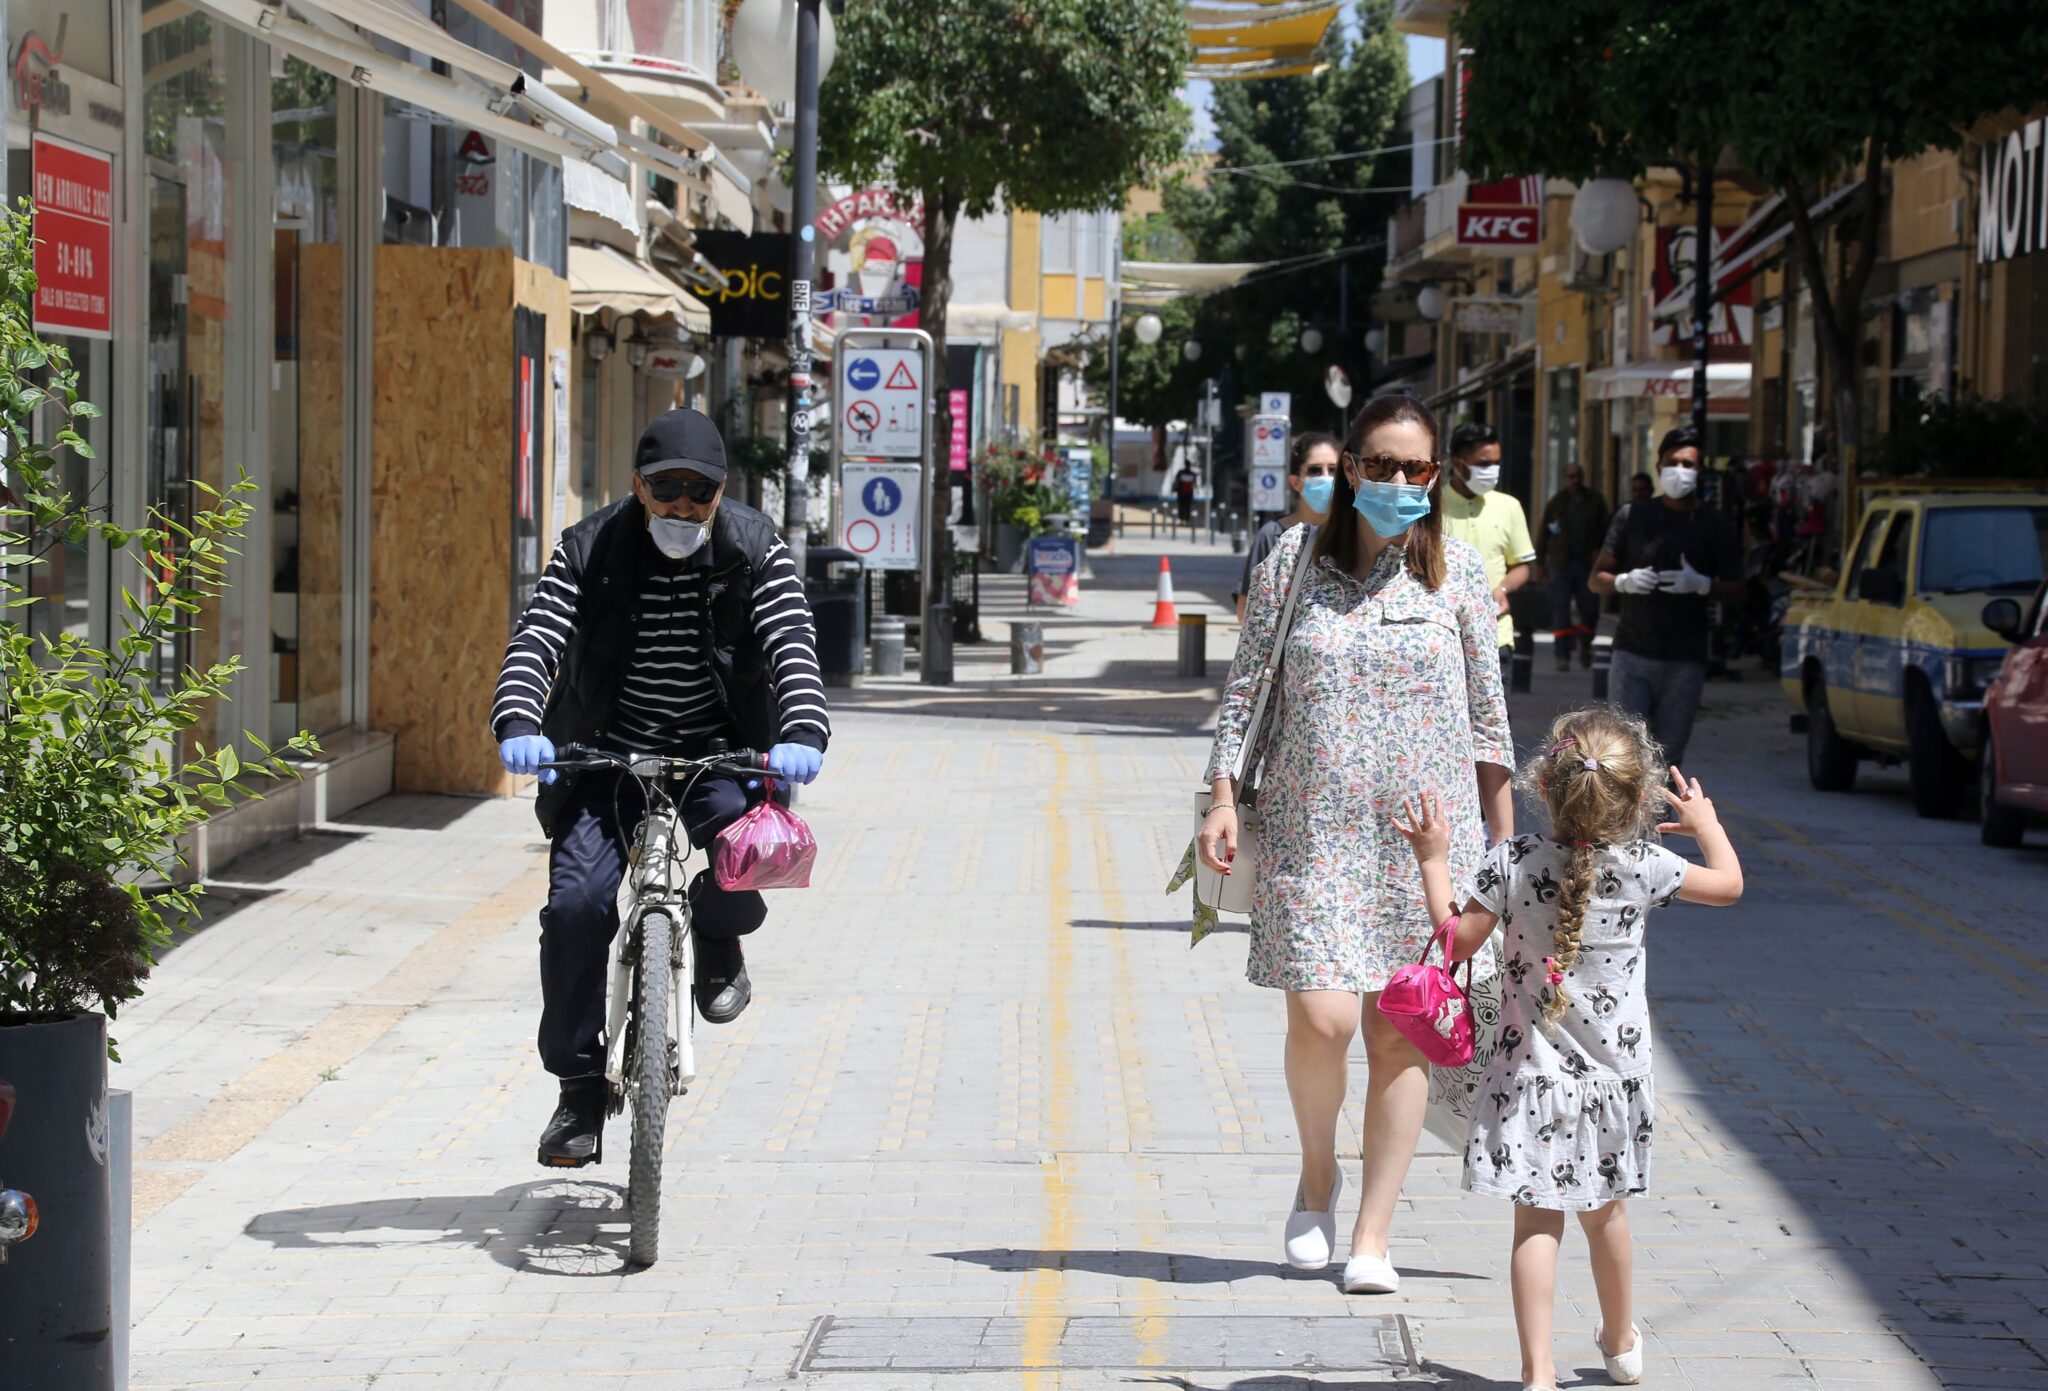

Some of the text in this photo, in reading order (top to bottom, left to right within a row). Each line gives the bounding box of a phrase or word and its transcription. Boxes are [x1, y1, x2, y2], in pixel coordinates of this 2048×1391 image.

[36, 172, 54, 205] NEW
[56, 177, 91, 214] ARRIVALS
[1463, 216, 1532, 238] KFC
[794, 282, 808, 309] BNE
[1643, 379, 1690, 396] KFC
